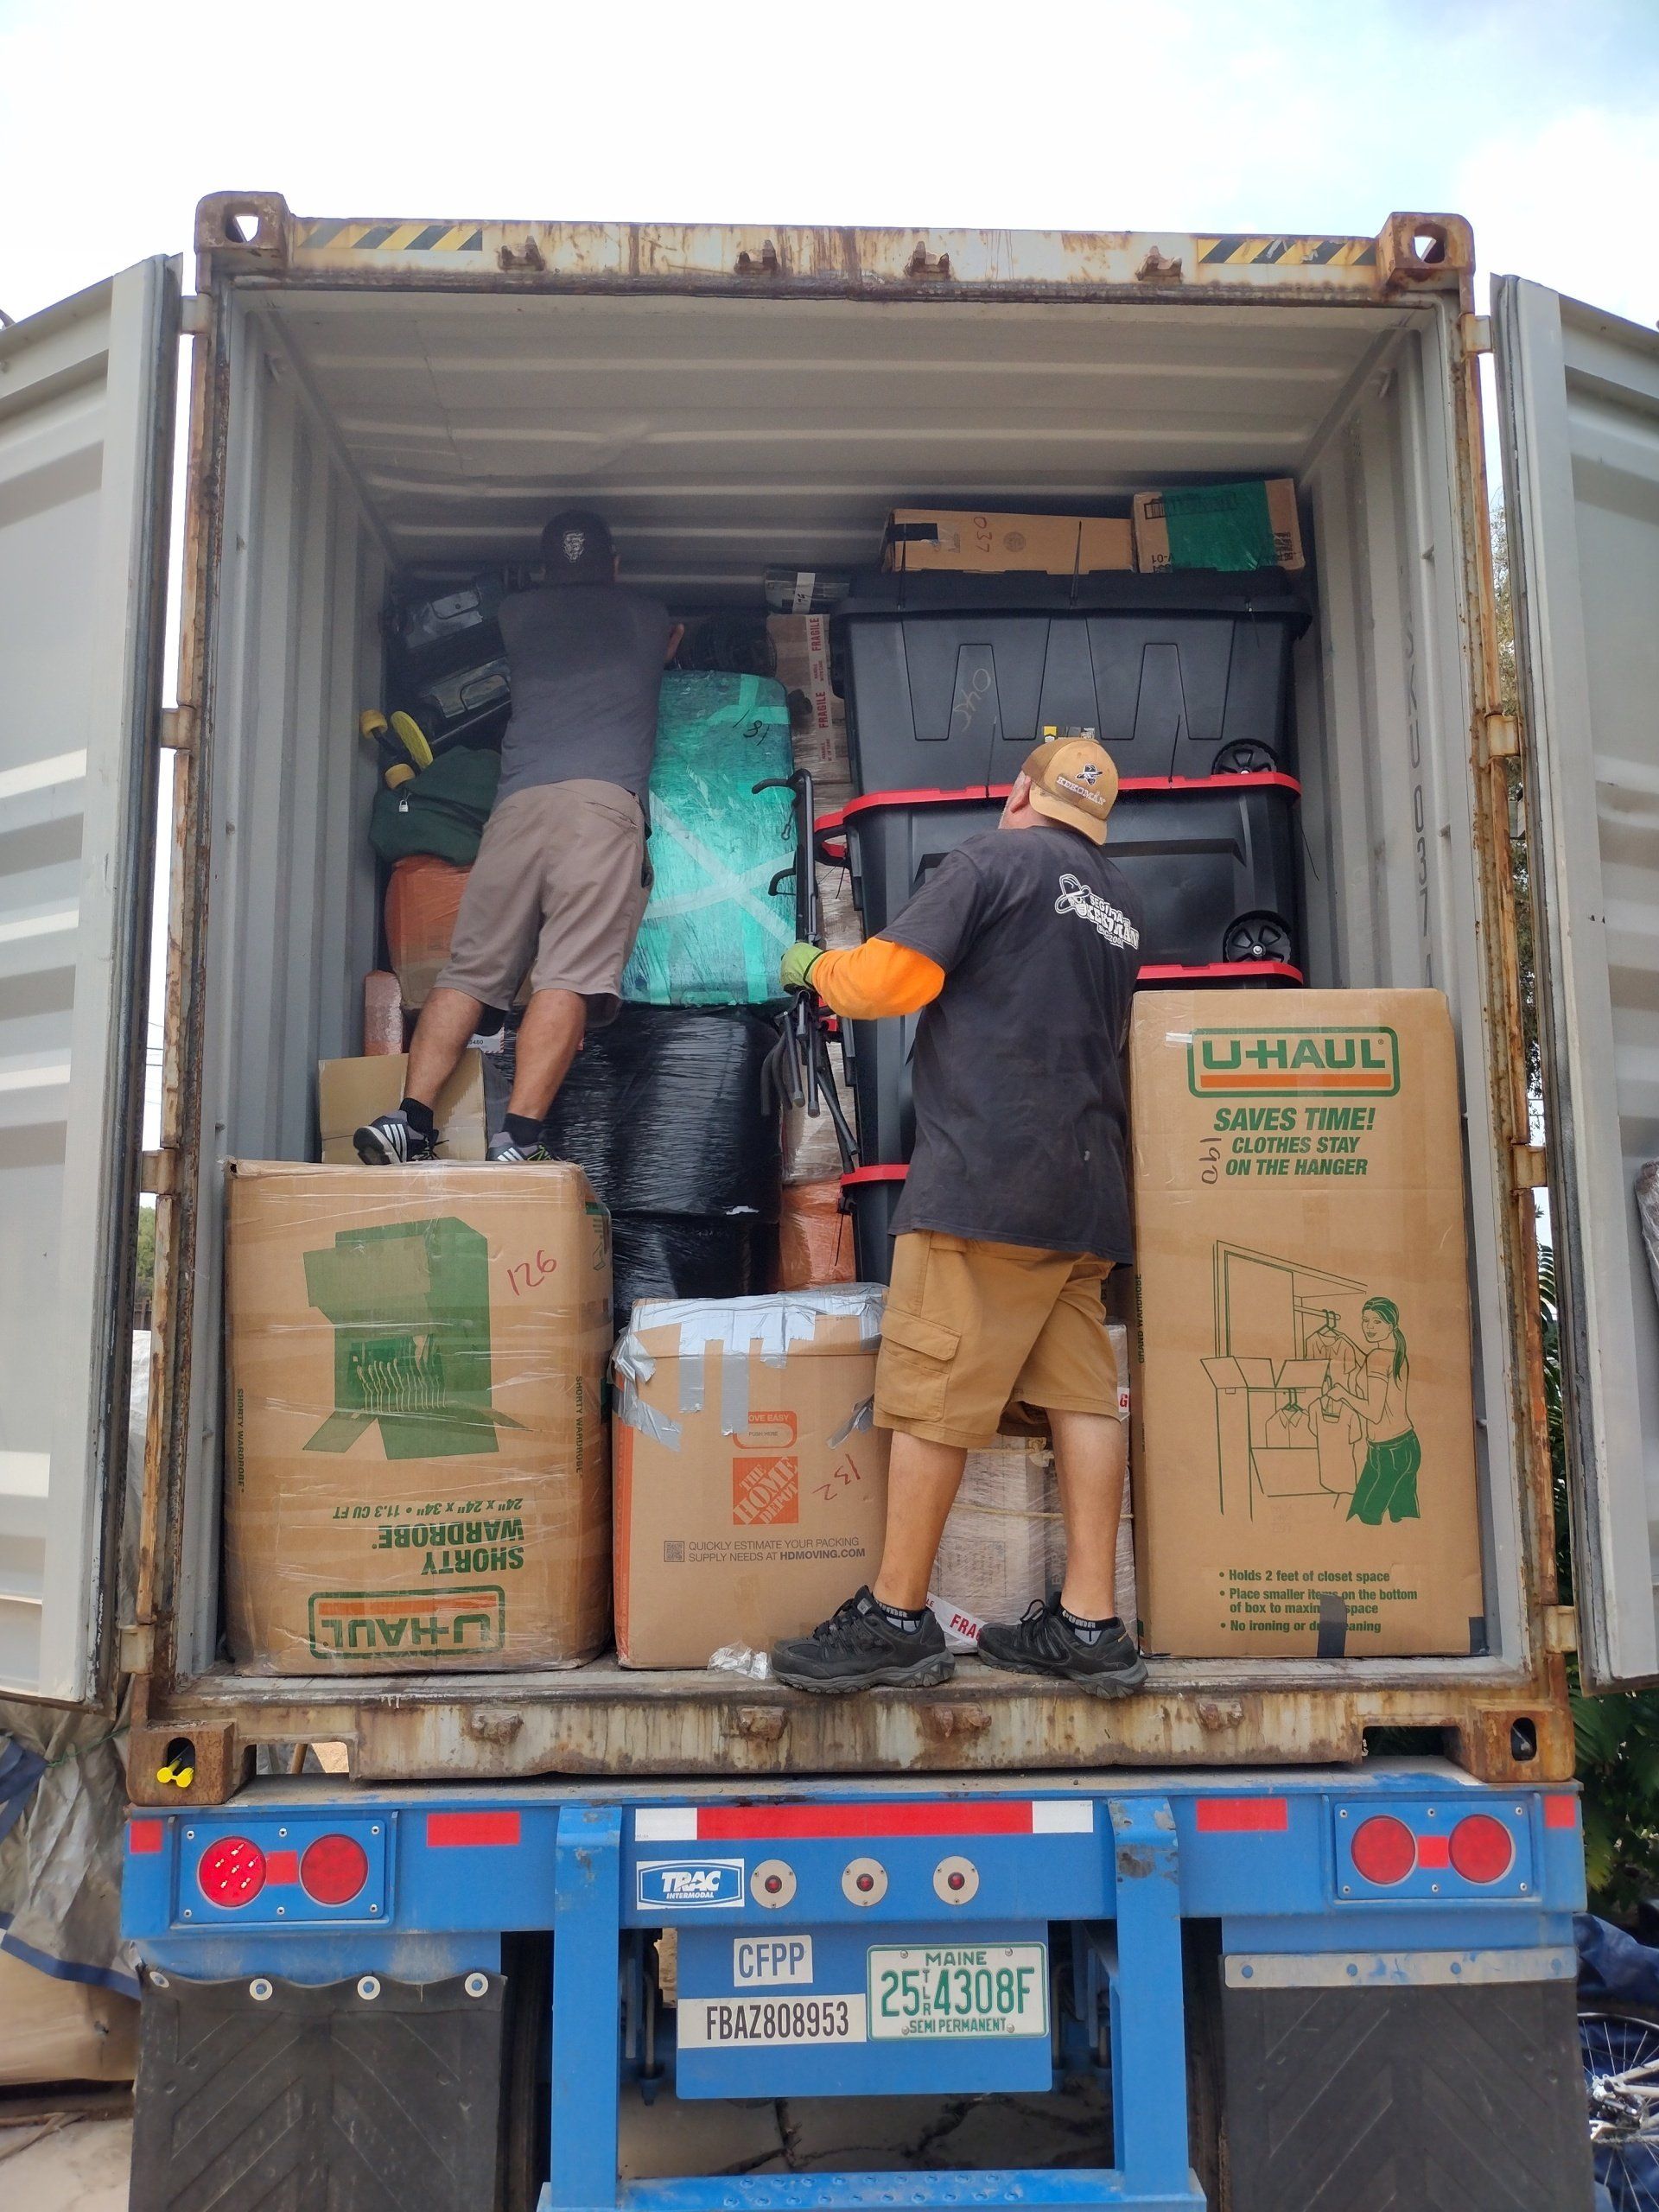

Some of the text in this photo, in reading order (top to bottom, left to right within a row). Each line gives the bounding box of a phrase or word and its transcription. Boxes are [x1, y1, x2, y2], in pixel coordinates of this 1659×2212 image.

[974, 516, 992, 553] 037
[809, 617, 822, 652] FRAGILE
[815, 690, 829, 729] FRAGILE
[1202, 1039, 1386, 1069] U-HAUL
[1213, 1107, 1376, 1132] SAVES TIME!
[1231, 1136, 1361, 1154] CLOTHES STAY
[1225, 1159, 1368, 1176] ON THE HANGER
[507, 1249, 557, 1296] 126
[748, 1414, 789, 1422] OVE EASY
[739, 1464, 766, 1491] THE
[812, 1452, 861, 1501] 132
[733, 1457, 798, 1524] HOME
[374, 1505, 400, 1518] 11.3
[416, 1503, 442, 1516] 34"
[458, 1501, 483, 1514] 24"
[499, 1498, 524, 1511] 24"
[759, 1480, 798, 1524] DEPOT
[333, 1506, 347, 1520] FT
[353, 1506, 371, 1519] CU
[377, 1517, 524, 1549] WARDROBE
[689, 1537, 860, 1552] QUICKLY ESTIMATE YOUR PACKING
[421, 1546, 524, 1575] SHORTY
[689, 1548, 865, 1562] SUPPLY NEEDS AT HDMOVING.COM
[1229, 1569, 1390, 1584] Holds 2 feet of closet space
[1230, 1587, 1260, 1599] Place
[1263, 1588, 1305, 1600] smaller
[1341, 1591, 1355, 1600] on
[1358, 1589, 1376, 1600] the
[1379, 1589, 1418, 1600] bottom
[1230, 1602, 1241, 1613] of
[1245, 1602, 1267, 1613] box
[1270, 1603, 1281, 1613] to
[1345, 1605, 1378, 1616] space
[321, 1613, 491, 1648] U-HAUL
[1230, 1620, 1246, 1631] No
[1249, 1620, 1290, 1633] ironing
[1294, 1622, 1306, 1631] or
[661, 1870, 721, 1892] TRAC
[738, 1942, 804, 1979] CFPP
[925, 1950, 987, 1967] MAINE
[880, 1969, 919, 2018] 25
[933, 1967, 1035, 2016] 4308F
[707, 2000, 850, 2040] FBAZ808953
[909, 2018, 1007, 2034] SEMI PERMANENT
